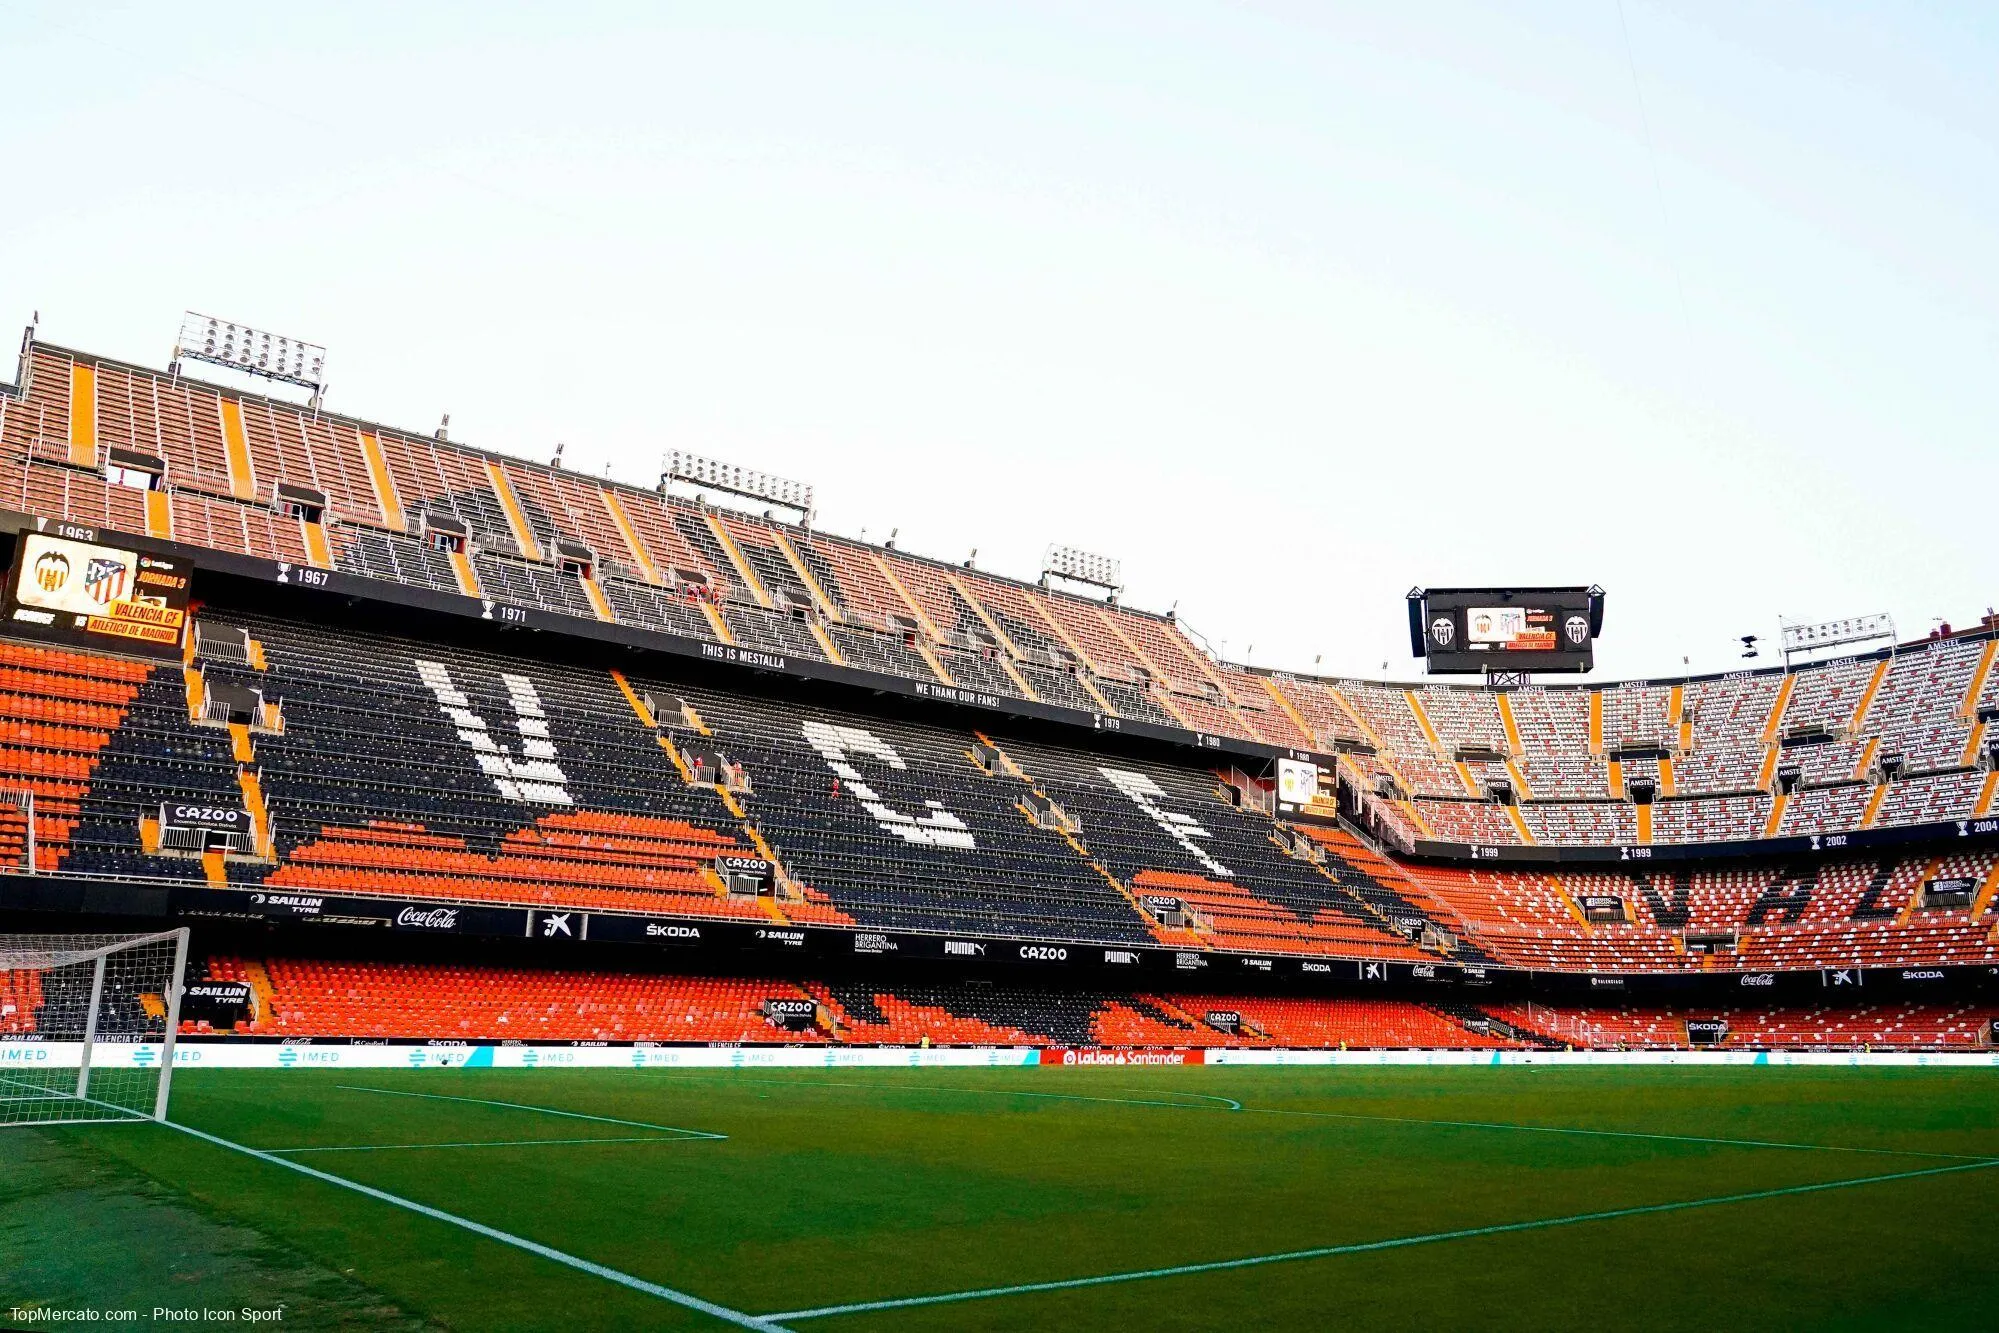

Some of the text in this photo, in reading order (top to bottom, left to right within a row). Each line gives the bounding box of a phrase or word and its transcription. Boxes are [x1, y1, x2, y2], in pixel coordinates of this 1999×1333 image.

[137, 571, 187, 589] JORNADA 3
[298, 568, 328, 587] 1967
[114, 602, 179, 624] VALENCIA CF
[501, 606, 527, 623] 1971
[141, 627, 175, 640] MADRID
[702, 643, 785, 669] THIS IS MESTALLA
[915, 682, 1000, 708] WE THANK OUR FANS!
[1104, 717, 1120, 730] 1979
[1205, 736, 1220, 747] 1980
[1630, 779, 1655, 787] AMSTEL
[175, 806, 238, 822] CAZOO
[1974, 820, 1998, 833] 2004
[1826, 835, 1848, 847] 2002
[1480, 847, 1499, 858] 1999
[1631, 848, 1652, 859] 1999
[726, 857, 767, 870] CAZOO
[268, 895, 323, 907] SAILUN
[1147, 896, 1176, 906] CAZOO
[397, 906, 460, 929] Coca-Cola
[646, 924, 700, 938] ŠKODA
[767, 932, 805, 941] SAILUN
[855, 933, 887, 942] HERRERO
[855, 941, 898, 950] BRIGANTINA
[944, 941, 976, 955] PUMA
[1019, 946, 1068, 960] CAZOO
[1104, 951, 1132, 963] PUMA
[1176, 959, 1208, 967] BRIGANTINA
[1249, 959, 1272, 967] SAILUN
[1302, 962, 1331, 973] ŠKODA
[1740, 973, 1775, 986] Coca-Cola
[1902, 971, 1944, 979] ŠKODA
[189, 986, 248, 996] SAILUN
[770, 1001, 812, 1012] CAZOO
[1210, 1013, 1238, 1021] CAZOO
[1688, 1022, 1726, 1031] ŠKODA
[428, 1039, 468, 1047] ŠKODA
[302, 1052, 340, 1062] IMED
[542, 1054, 574, 1062] IMED
[1077, 1051, 1185, 1065] LaLiga Santander
